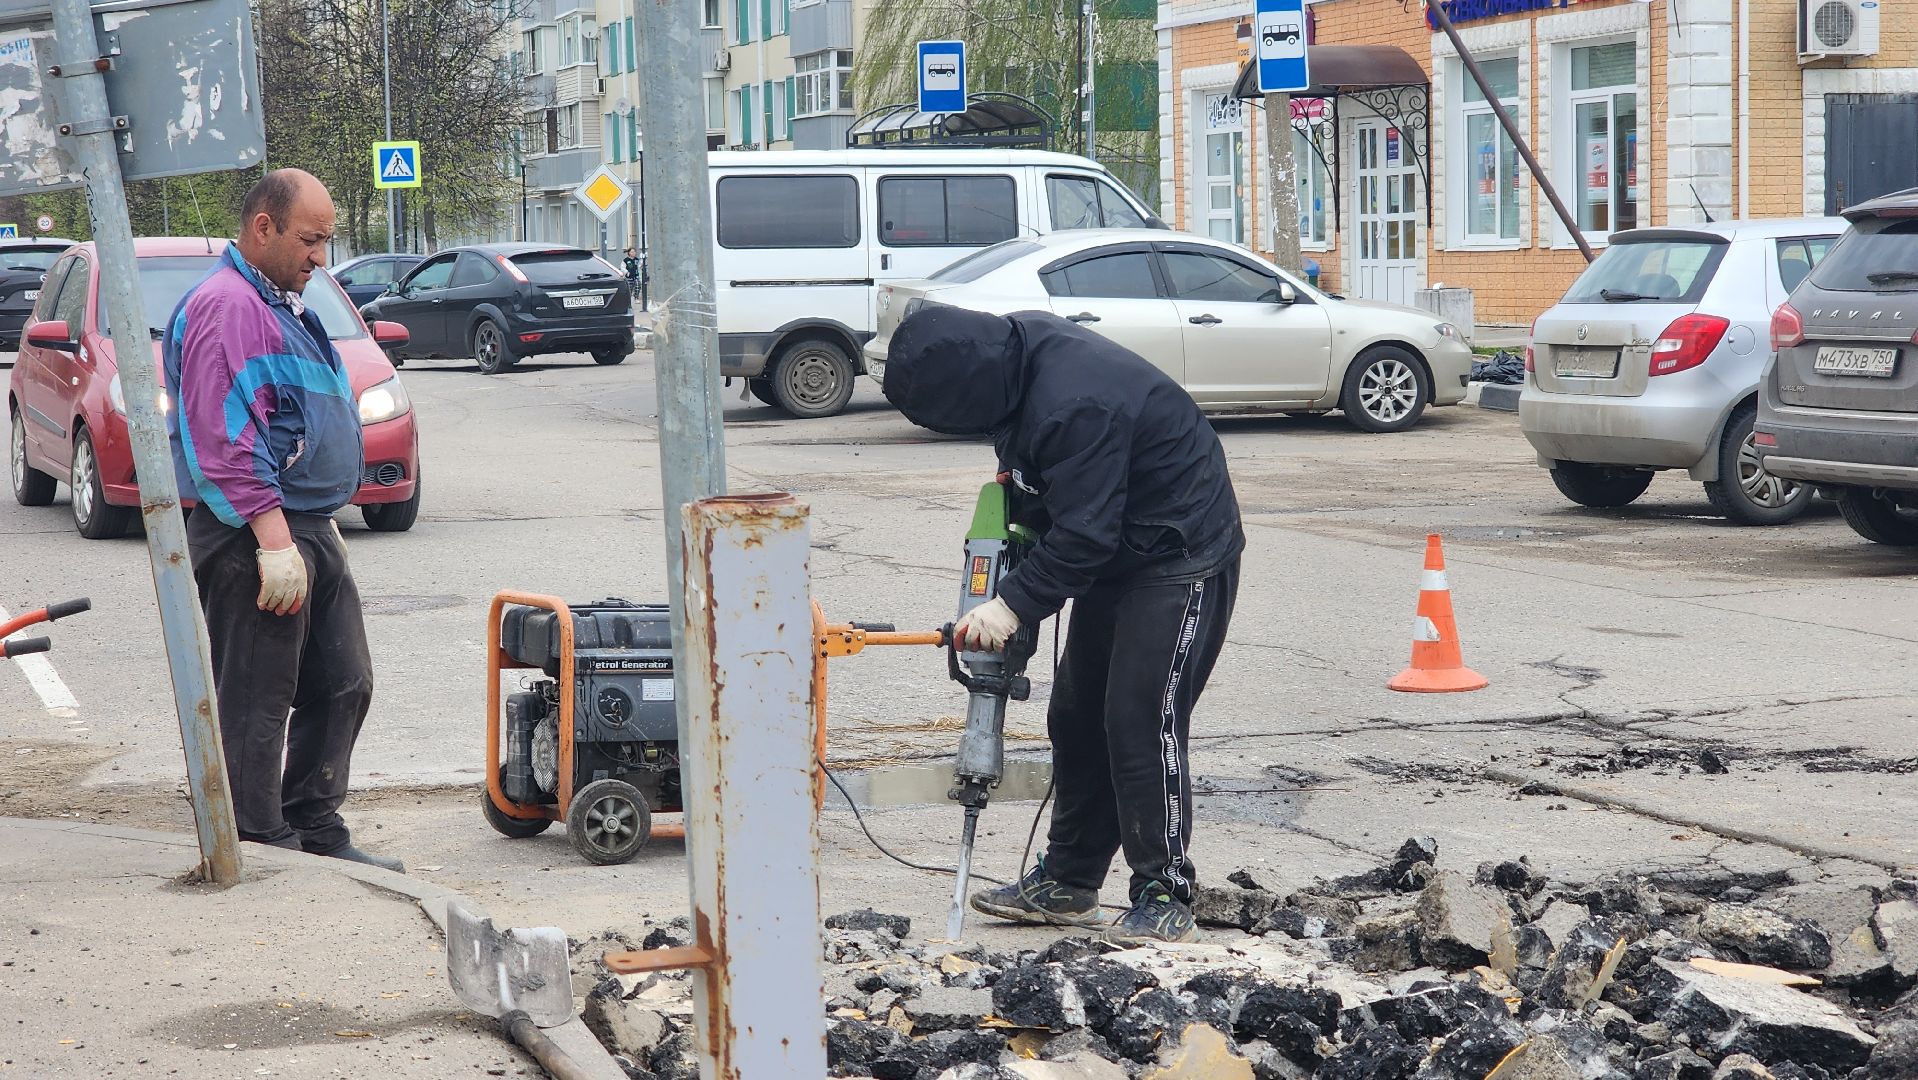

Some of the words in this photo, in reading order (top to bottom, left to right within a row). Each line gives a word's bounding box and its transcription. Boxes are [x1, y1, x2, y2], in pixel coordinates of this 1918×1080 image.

[1812, 309, 1903, 320] HAVAL
[1818, 350, 1868, 368] М473ХВ
[1872, 350, 1893, 364] 750
[621, 660, 669, 669] Generator
